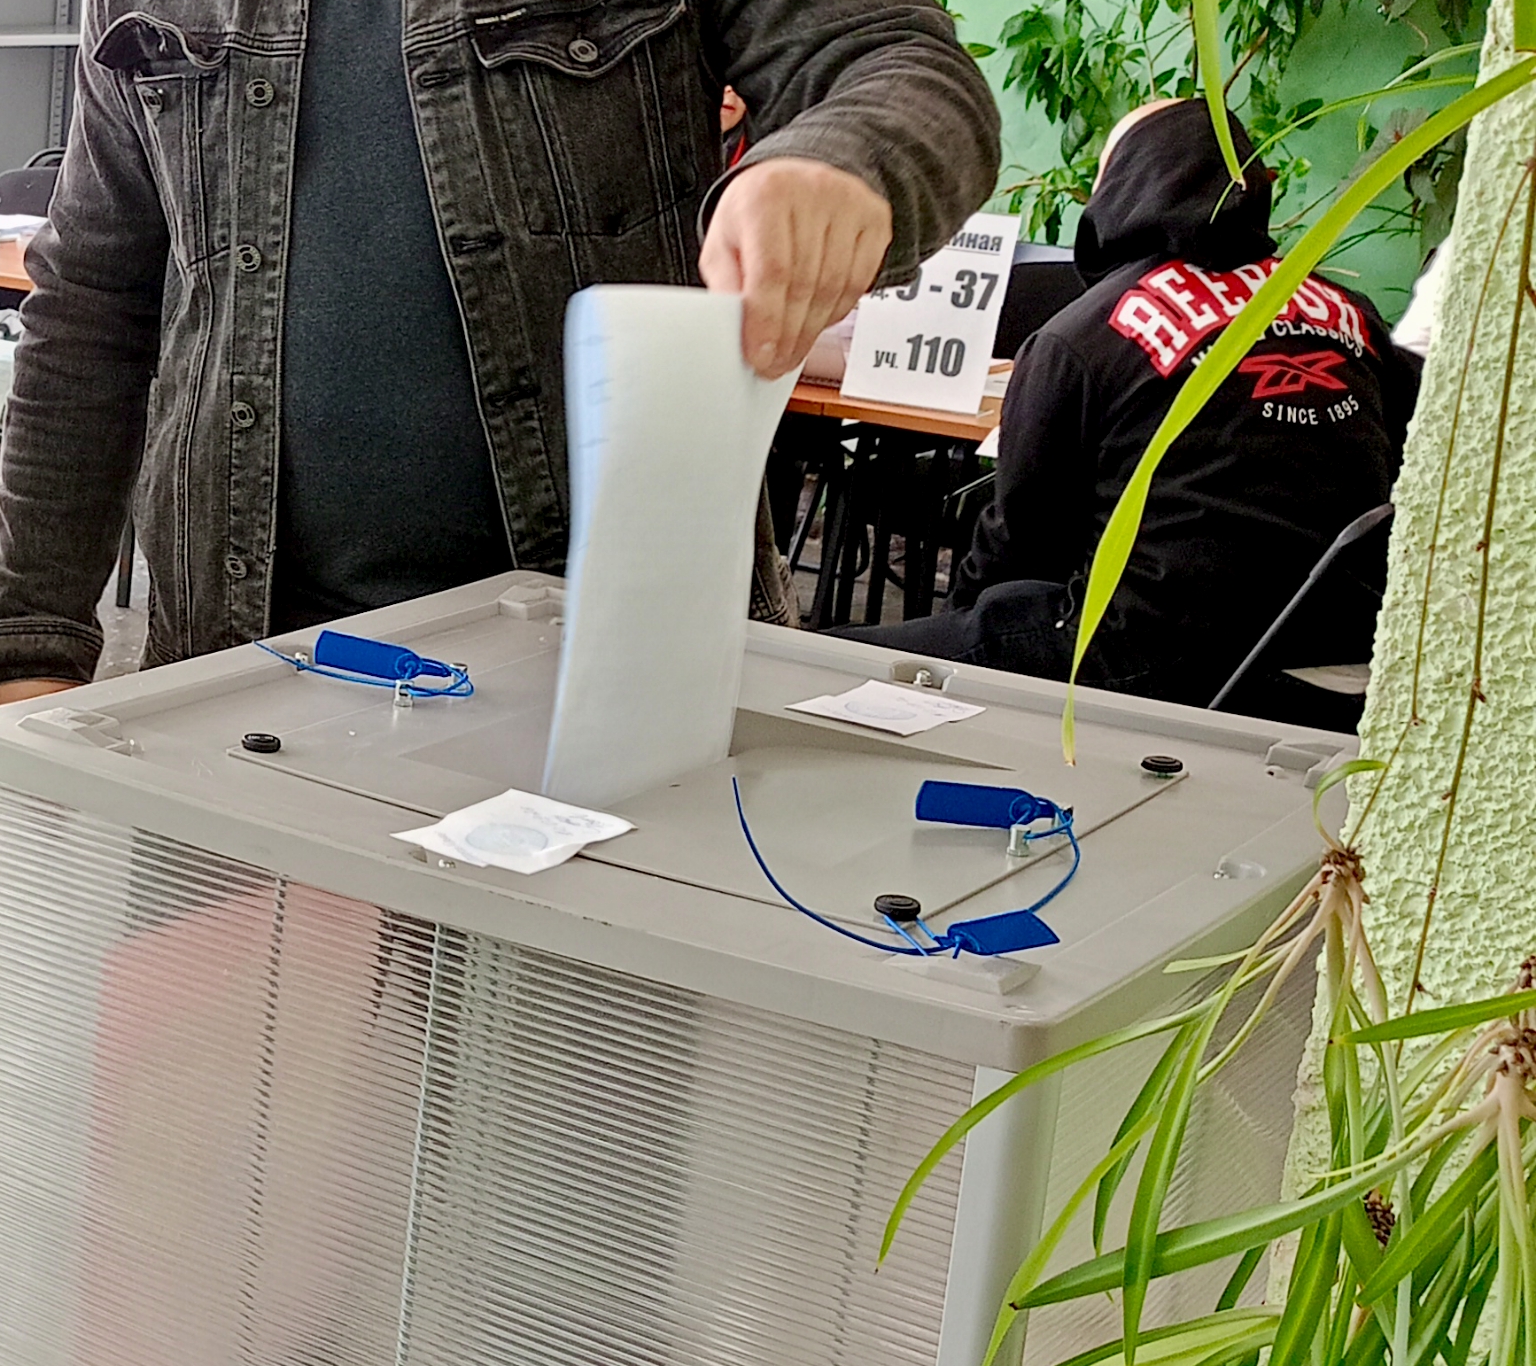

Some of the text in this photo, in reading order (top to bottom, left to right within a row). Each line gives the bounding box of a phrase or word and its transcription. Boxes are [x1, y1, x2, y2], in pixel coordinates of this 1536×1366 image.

[951, 232, 1003, 252] иная
[950, 269, 1000, 311] 37
[872, 333, 966, 377] уч. 110
[1262, 394, 1359, 425] SINCE 1895
